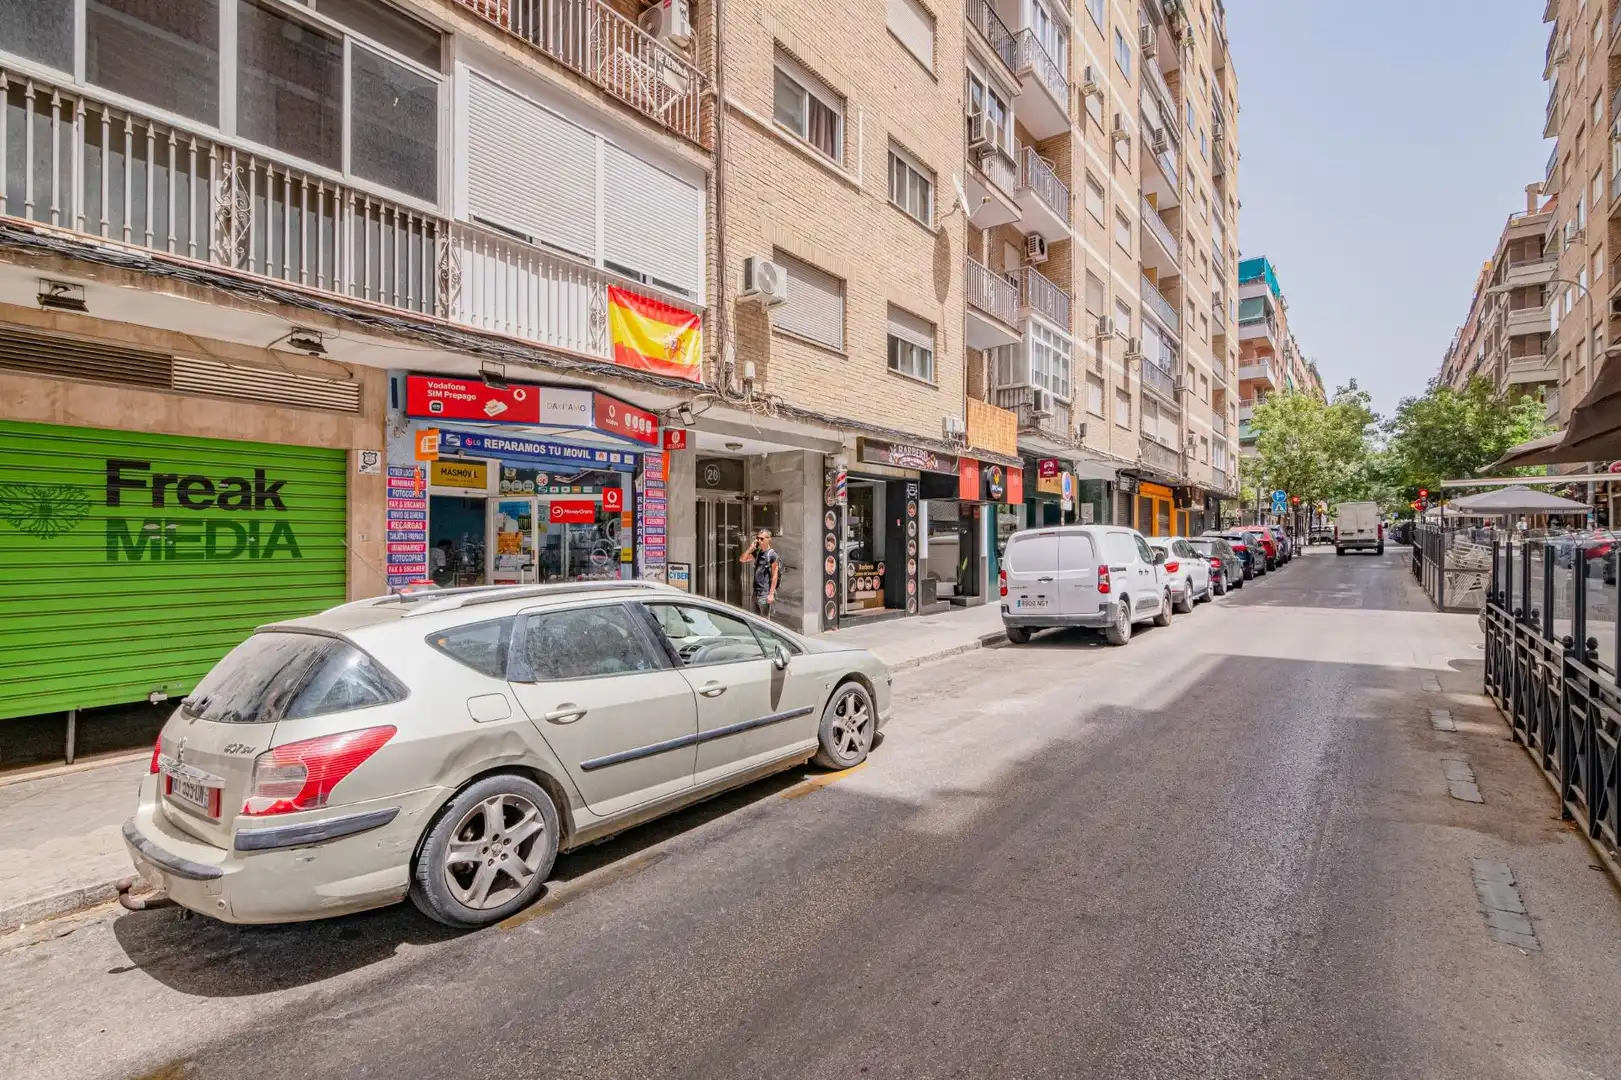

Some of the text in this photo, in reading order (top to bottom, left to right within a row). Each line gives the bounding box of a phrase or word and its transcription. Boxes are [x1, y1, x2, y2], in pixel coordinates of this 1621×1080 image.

[427, 381, 466, 391] Vodafone
[427, 389, 477, 401] SIM Prepago
[484, 438, 546, 455] REPARAMOS
[548, 445, 561, 456] TU
[563, 447, 592, 459] MOVIL
[707, 469, 718, 480] 20
[105, 458, 288, 512] Freak
[389, 500, 398, 508] FAX
[563, 508, 593, 516] MoneyGram
[391, 521, 423, 529] RECARGAS
[105, 518, 304, 562] MEDIA
[669, 571, 688, 580] CYBER
